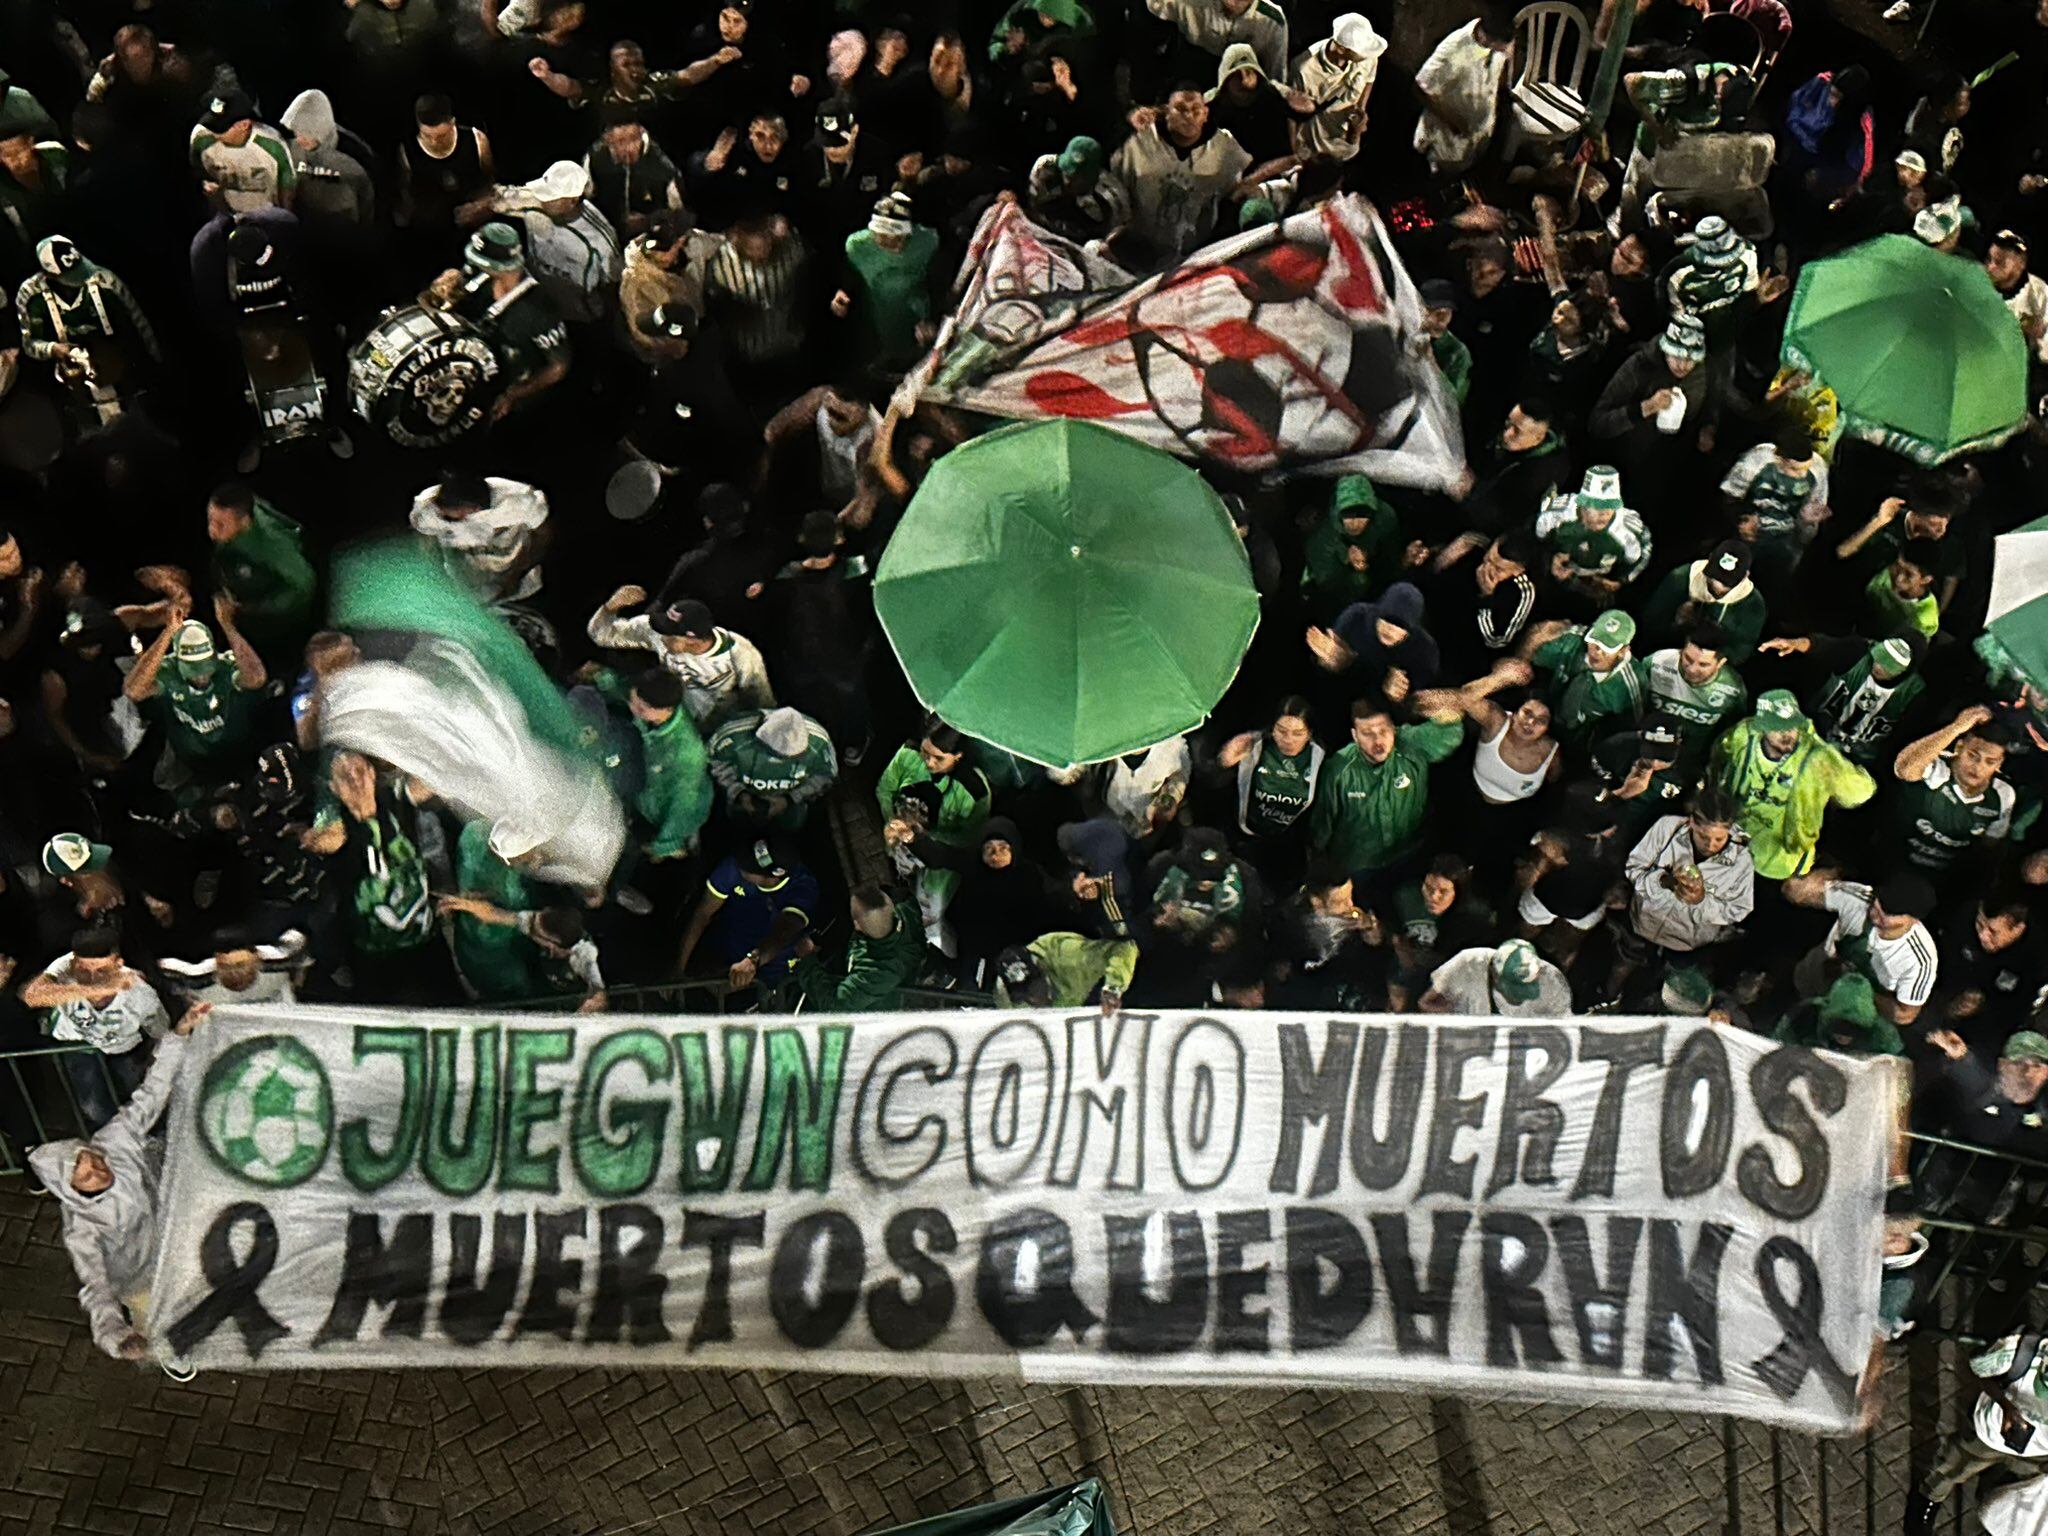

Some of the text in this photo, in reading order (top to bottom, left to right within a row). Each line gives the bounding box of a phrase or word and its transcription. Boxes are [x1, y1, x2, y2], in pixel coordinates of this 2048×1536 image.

[338, 1013, 1848, 1222] JUEGAN COMO MUERTOS
[310, 1202, 1735, 1386] MUERTOS QUEDARAN
